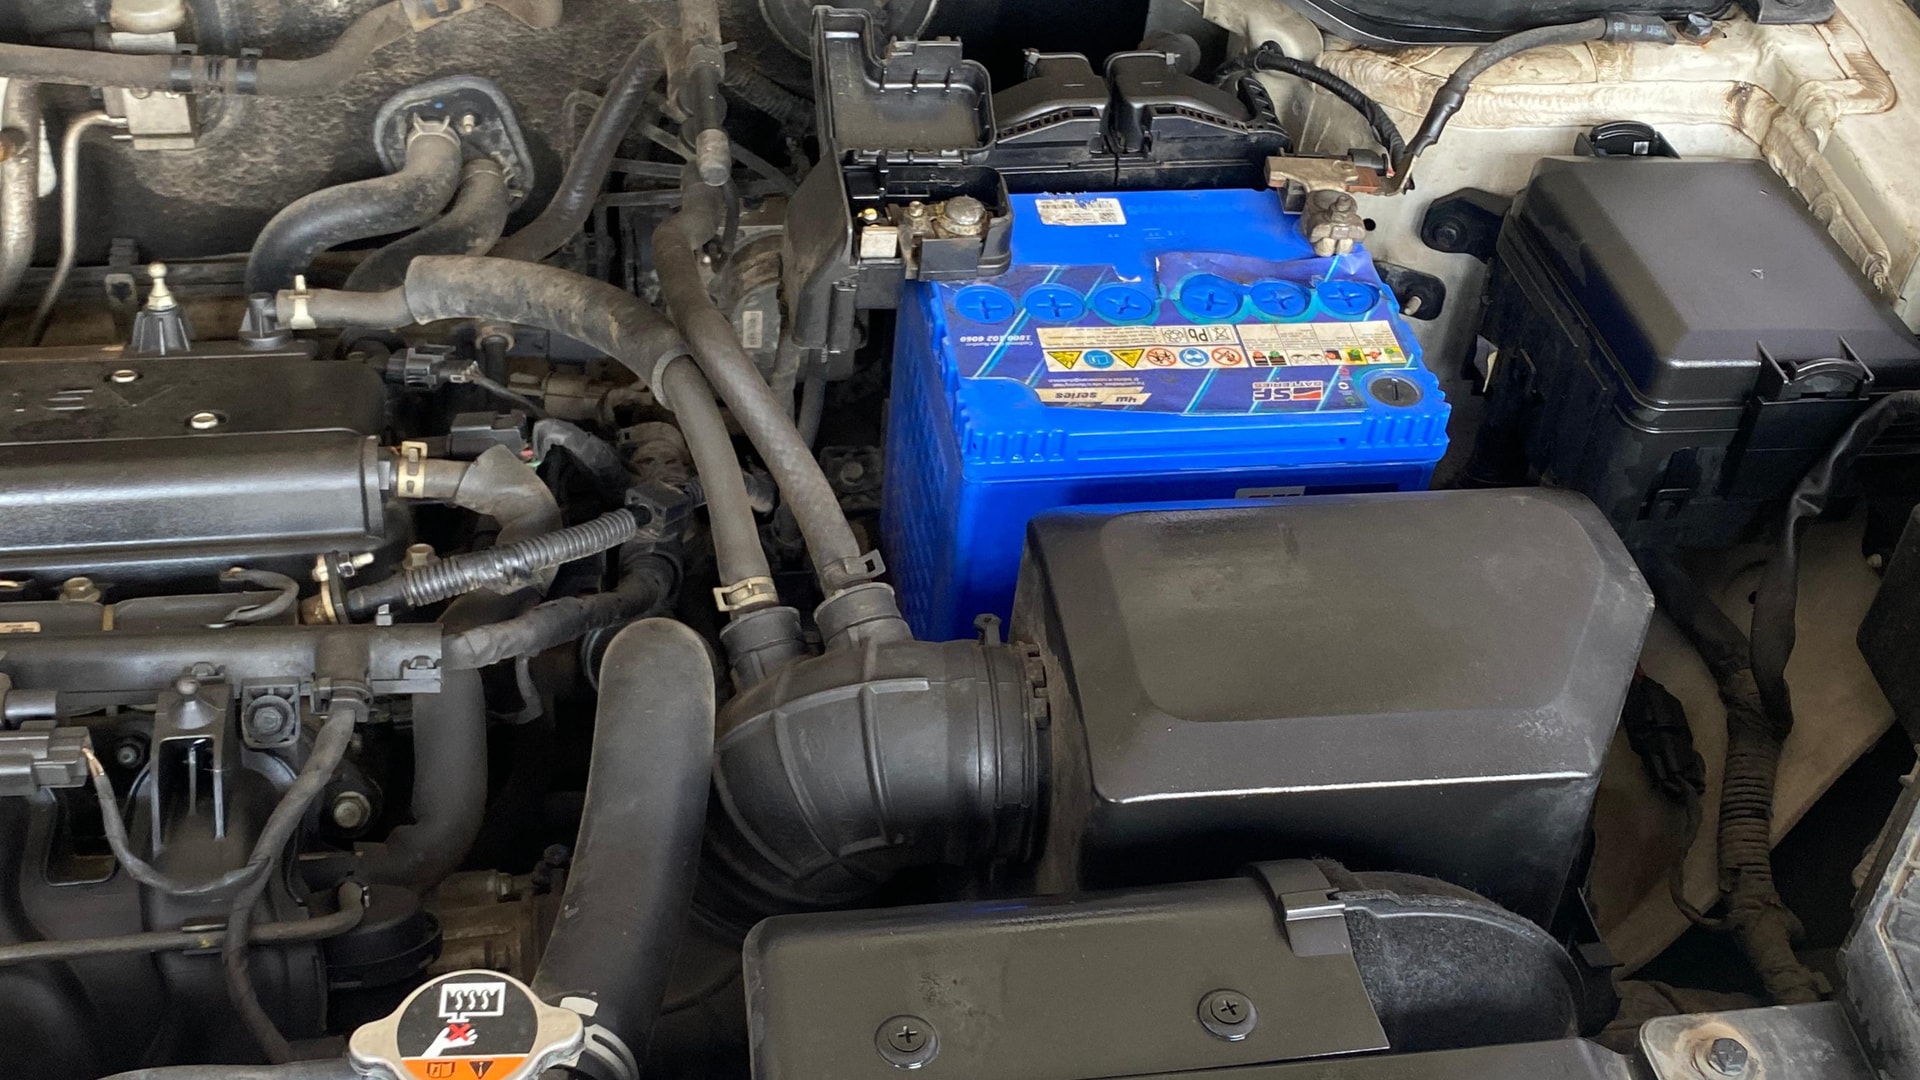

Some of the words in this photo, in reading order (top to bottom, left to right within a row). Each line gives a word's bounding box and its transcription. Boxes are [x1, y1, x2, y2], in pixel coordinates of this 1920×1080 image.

[1188, 328, 1208, 341] Pb
[1055, 391, 1097, 400] series
[1253, 387, 1291, 401] SF
